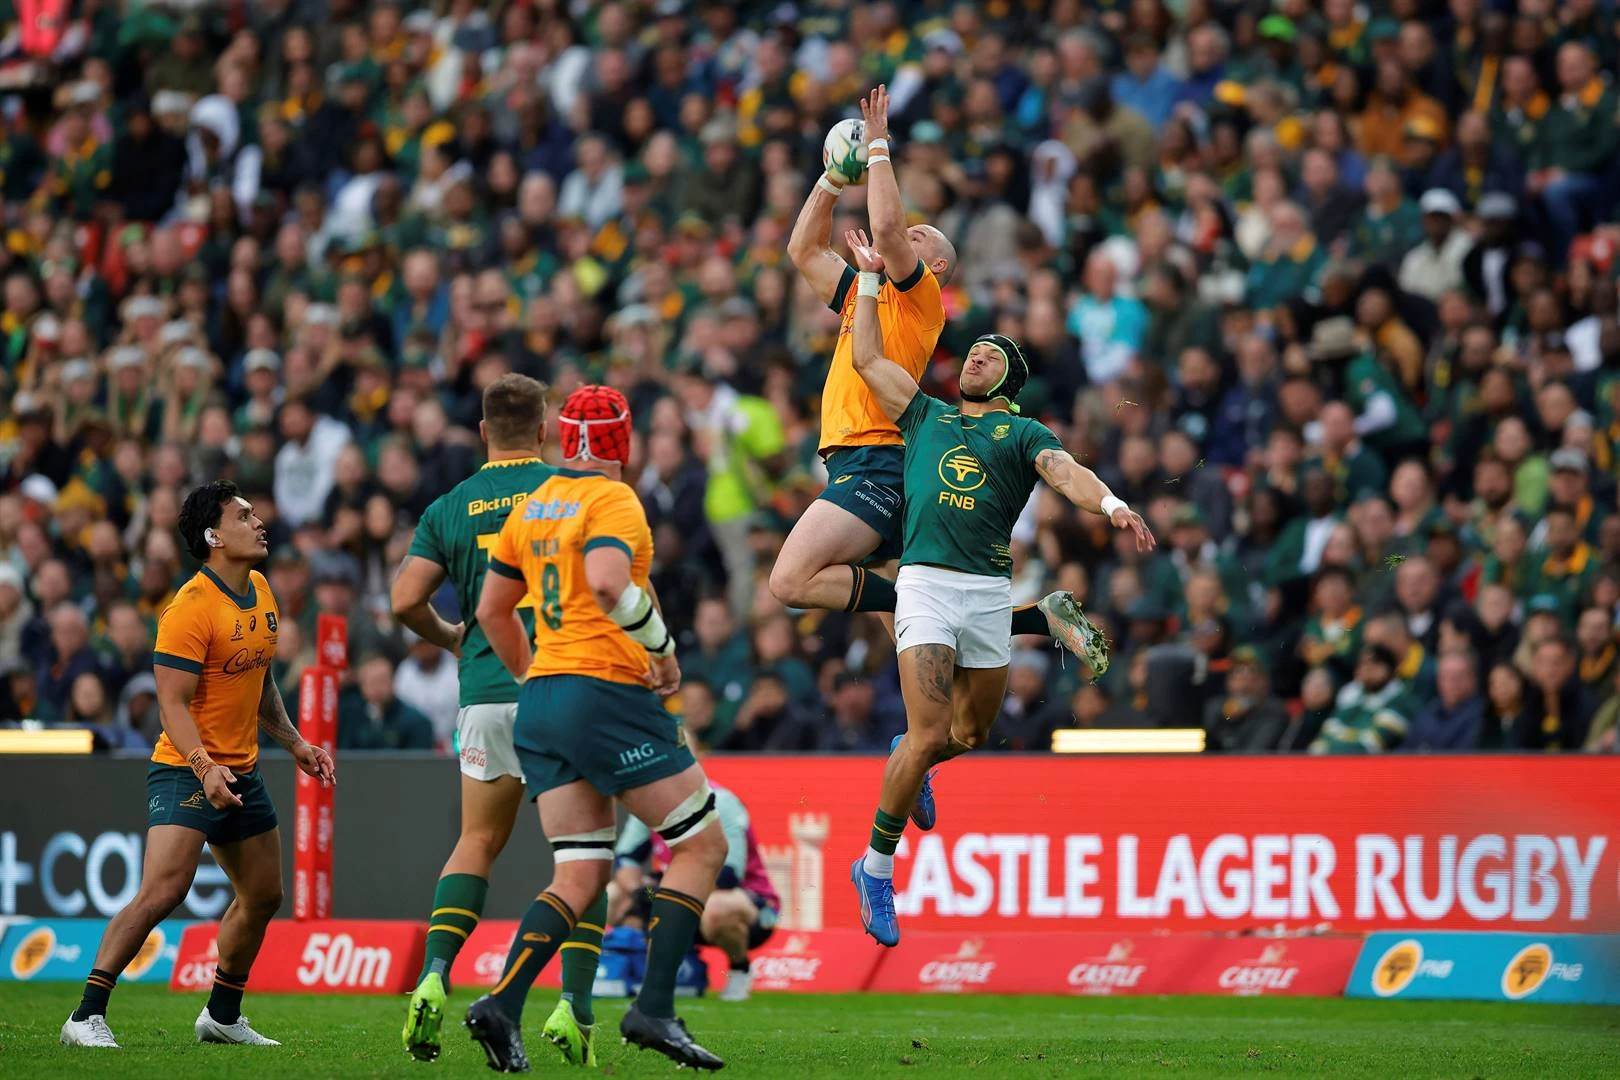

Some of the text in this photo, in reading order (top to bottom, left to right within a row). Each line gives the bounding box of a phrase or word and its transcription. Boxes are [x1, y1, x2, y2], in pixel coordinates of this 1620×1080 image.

[854, 490, 893, 518] DEFENDER
[938, 491, 976, 511] FNB
[541, 562, 563, 631] 8
[619, 742, 655, 765] IHG
[1115, 833, 1341, 920] LAGER
[1353, 834, 1609, 922] RUGBY
[295, 932, 393, 987] 50m
